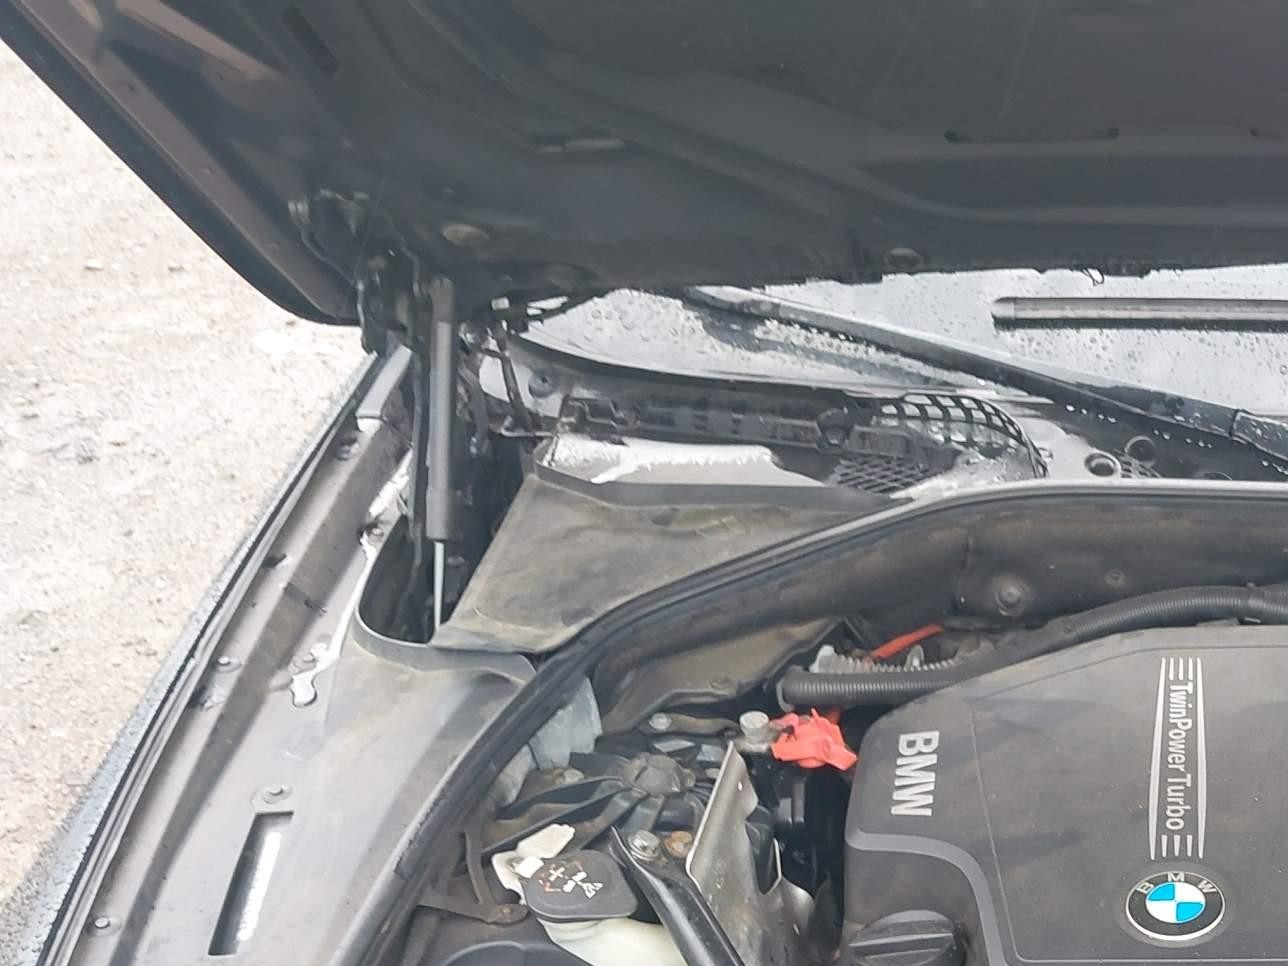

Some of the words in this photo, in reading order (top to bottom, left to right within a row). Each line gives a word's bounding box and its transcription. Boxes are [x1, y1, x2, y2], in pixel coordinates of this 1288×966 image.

[1166, 681, 1193, 773] TwinPower
[891, 730, 940, 817] BMW
[1165, 774, 1192, 831] Turbo
[1136, 871, 1217, 895] BMW
